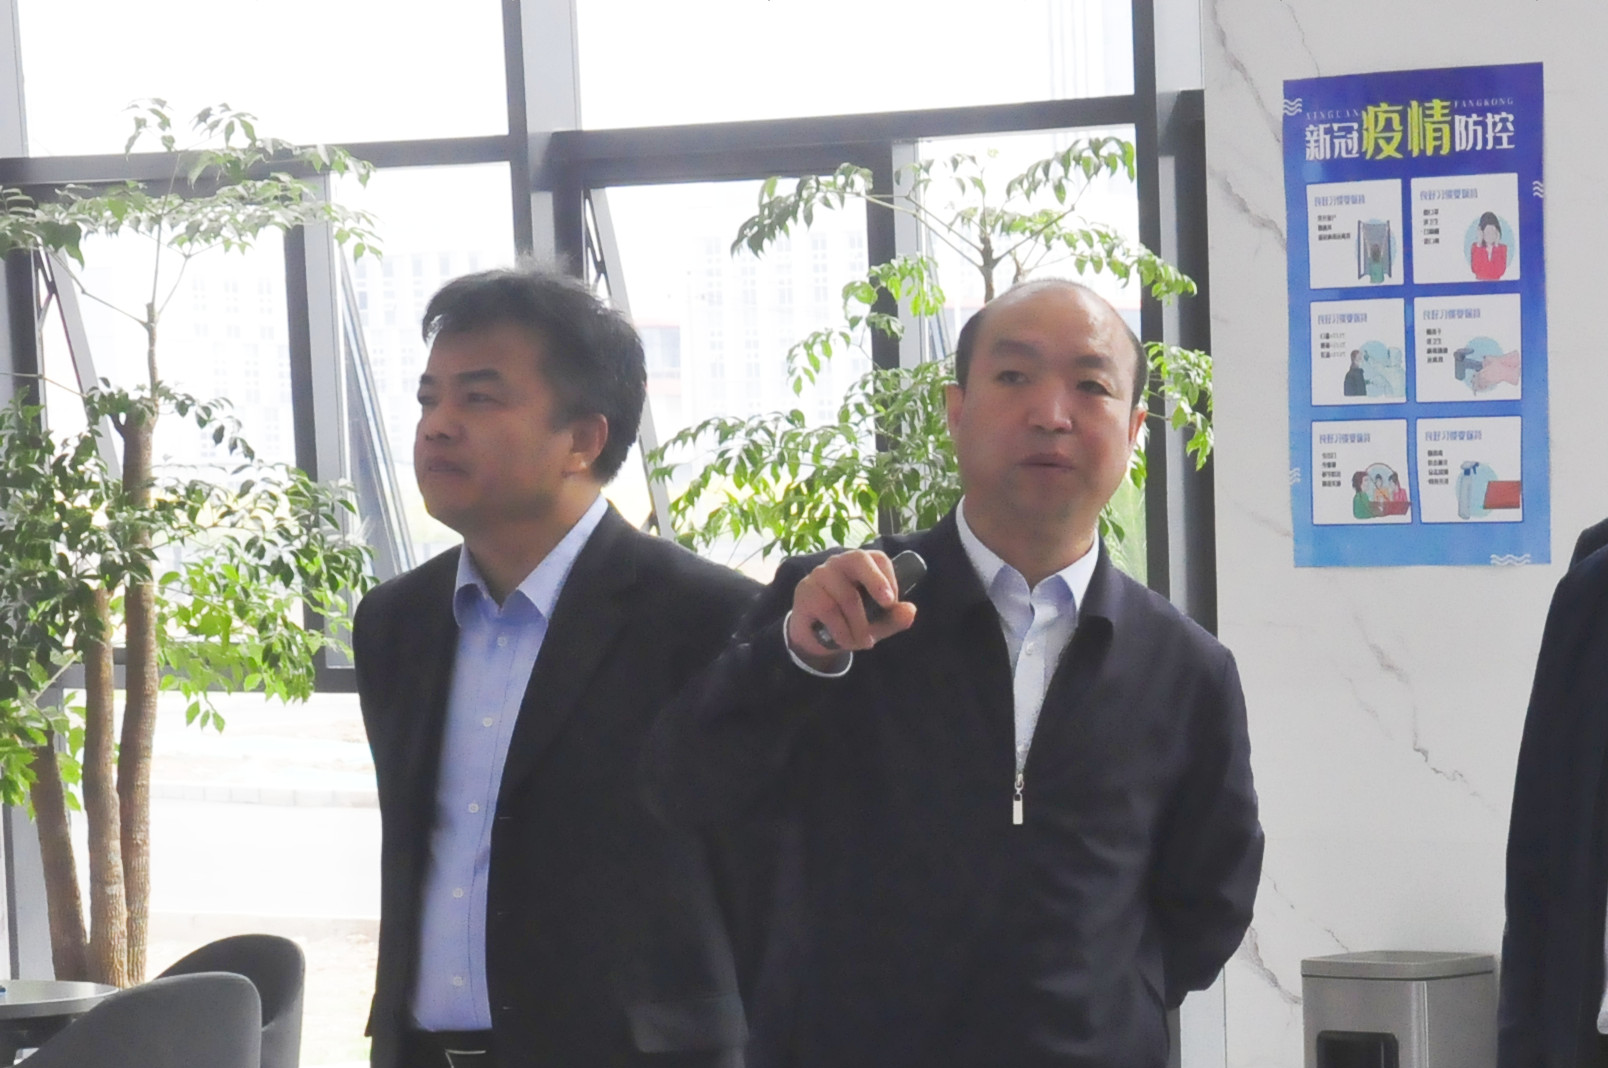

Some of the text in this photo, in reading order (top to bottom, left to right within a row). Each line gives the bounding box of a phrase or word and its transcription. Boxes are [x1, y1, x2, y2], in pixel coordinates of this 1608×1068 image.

[1305, 99, 1515, 161] 新冠疫情防控
